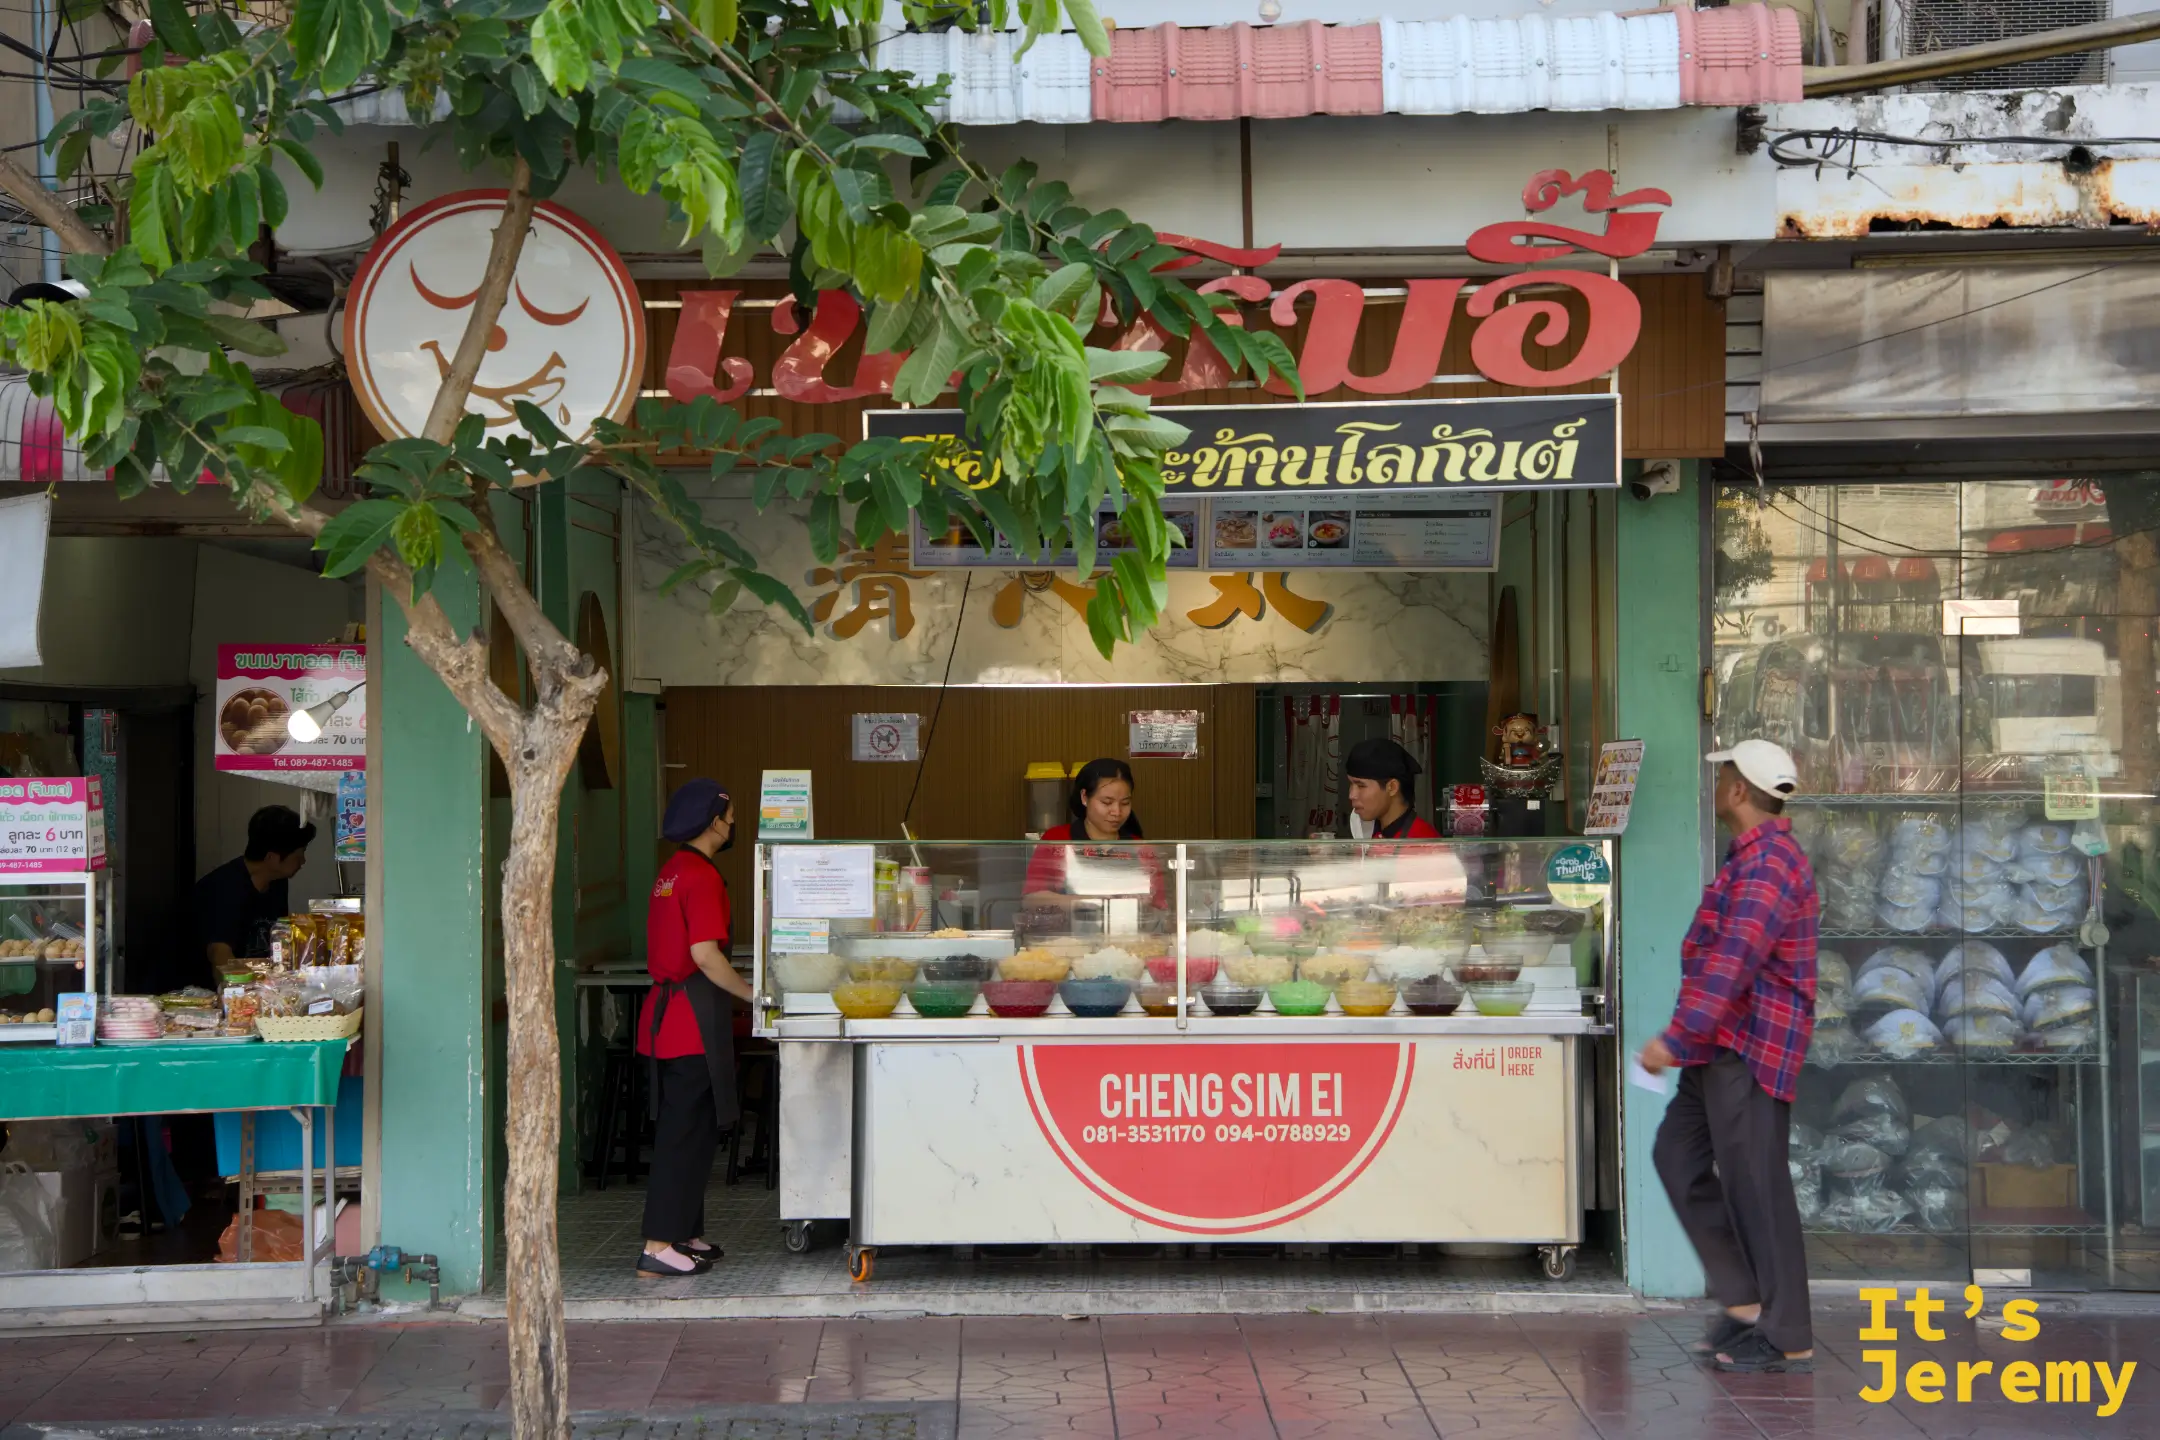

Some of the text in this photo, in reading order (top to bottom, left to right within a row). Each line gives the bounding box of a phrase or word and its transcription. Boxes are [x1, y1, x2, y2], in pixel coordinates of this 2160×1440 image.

[333, 735, 347, 745] 70
[273, 758, 354, 768] Tel. 089-487-1485
[0, 784, 24, 798] อด
[8, 827, 83, 844] ลูกละ 6 บาท
[26, 846, 37, 854] 70
[1555, 860, 1597, 877] Thumbs
[1452, 1048, 1496, 1070] สั่งที่นี่
[1507, 1046, 1543, 1059] ORDER
[1507, 1063, 1535, 1076] HERE
[1099, 1072, 1343, 1118] CHENG SIM EI
[1083, 1123, 1351, 1143] 081-3531170 094-0788929
